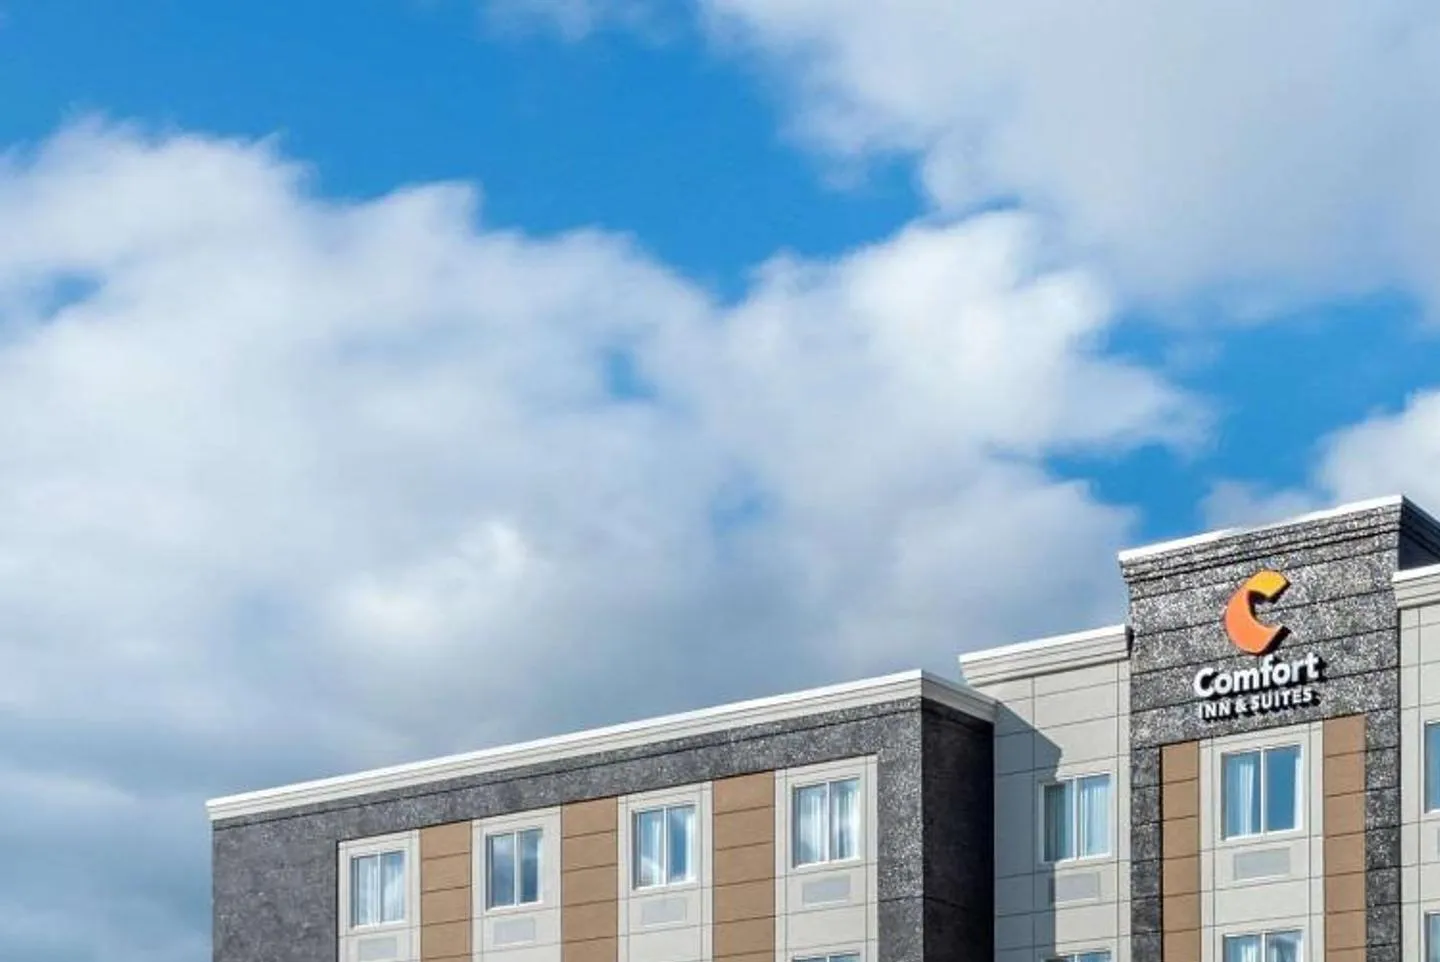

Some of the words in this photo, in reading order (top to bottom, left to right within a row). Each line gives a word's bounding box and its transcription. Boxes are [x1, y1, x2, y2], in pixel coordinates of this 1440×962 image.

[1193, 652, 1320, 698] Comfort
[1199, 701, 1232, 719] INN
[1235, 695, 1248, 713] &
[1250, 687, 1313, 711] SUITES
